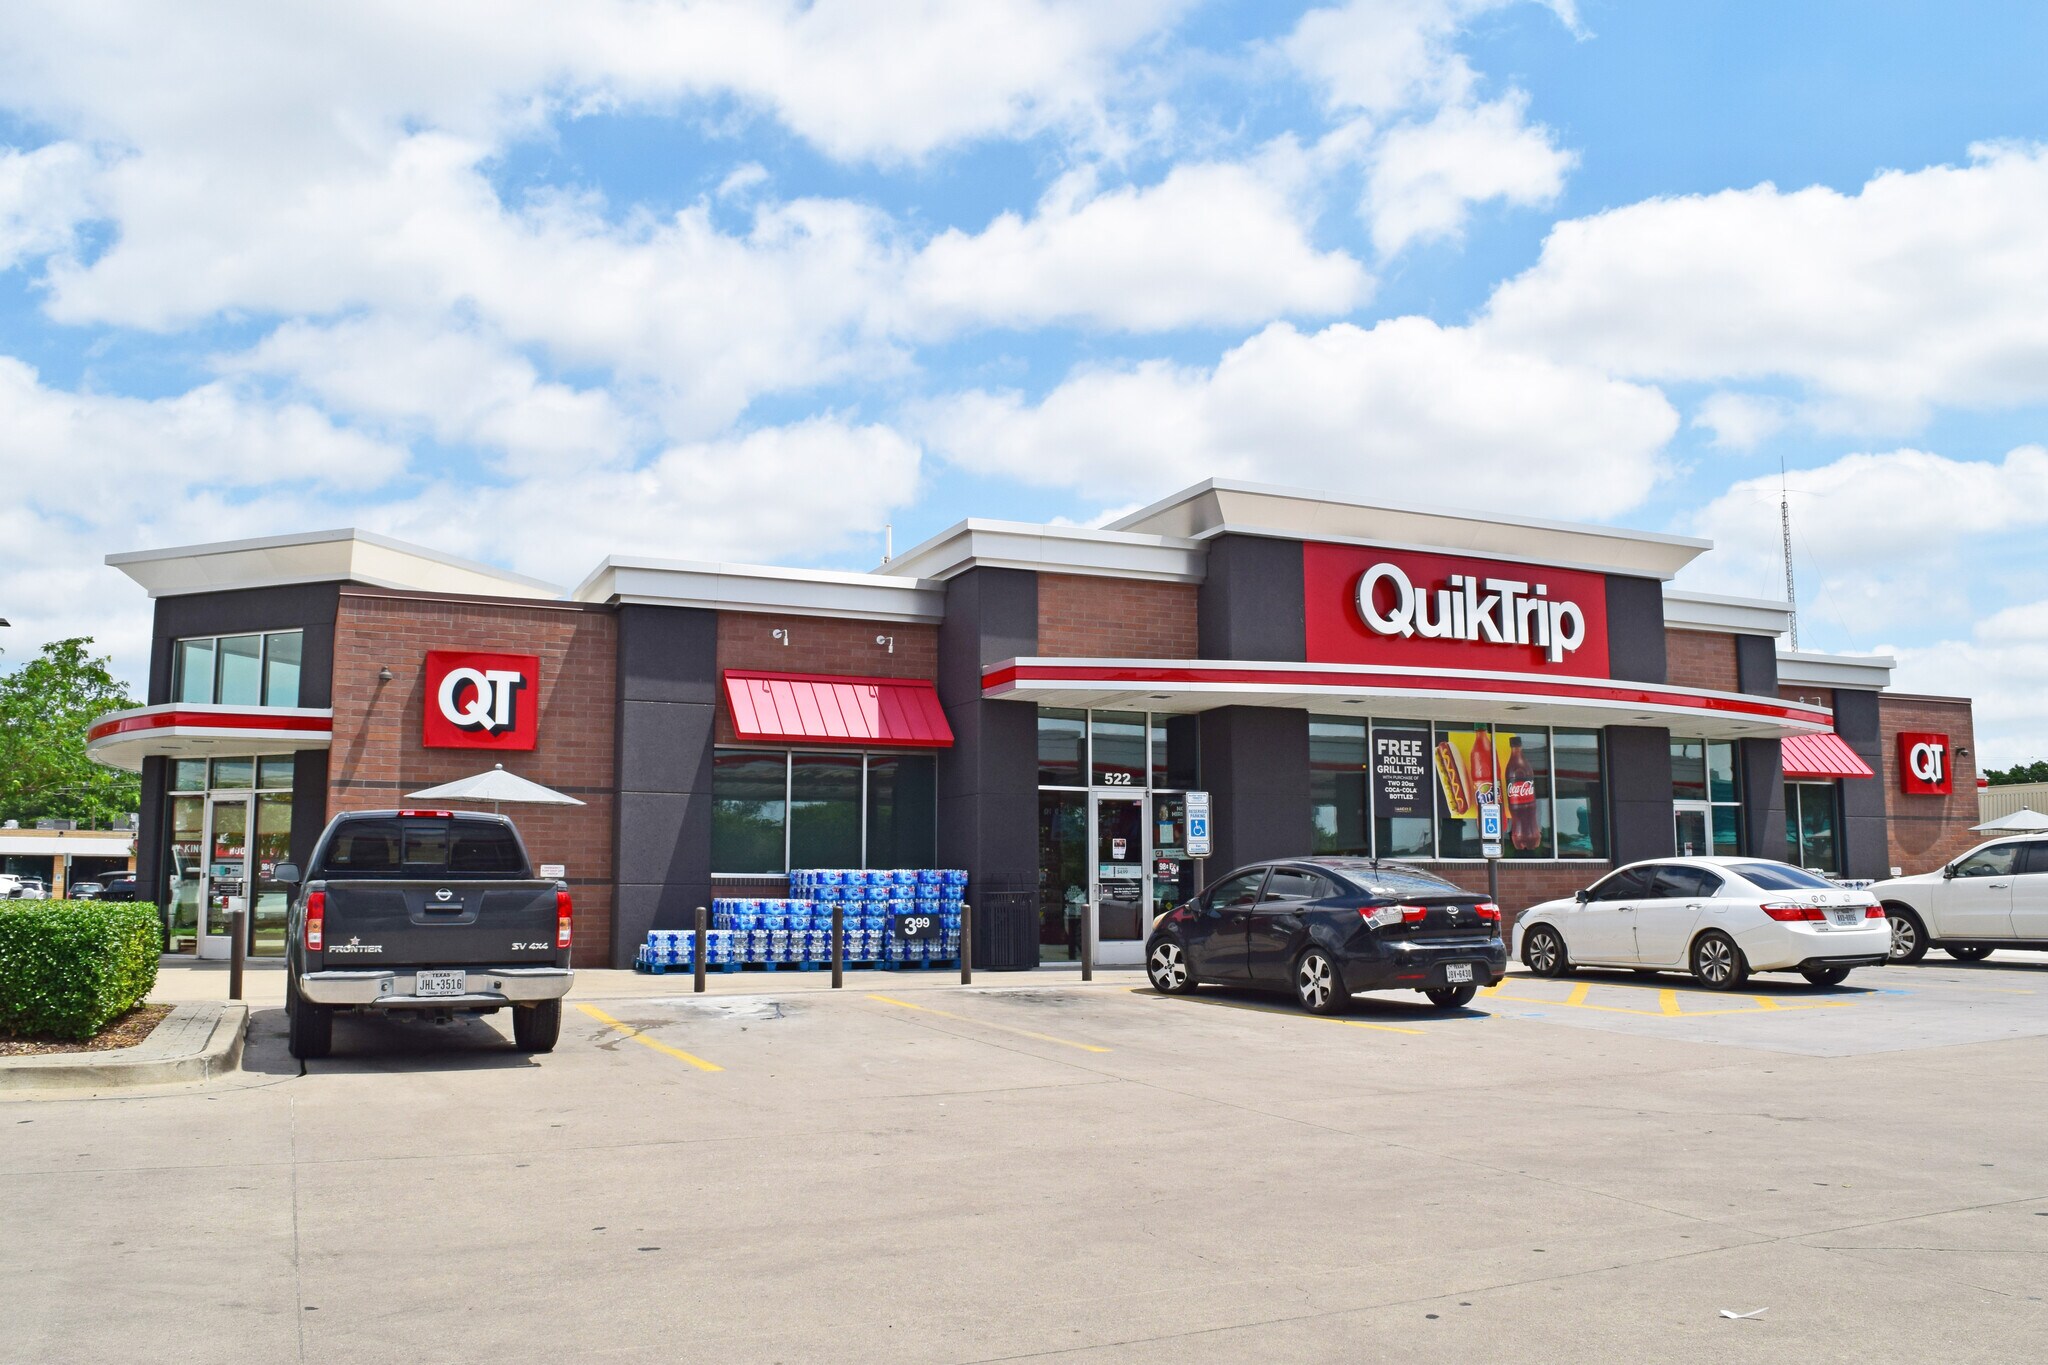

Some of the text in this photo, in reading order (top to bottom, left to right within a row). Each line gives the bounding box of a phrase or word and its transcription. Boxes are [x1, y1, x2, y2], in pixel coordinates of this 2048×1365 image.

[1356, 562, 1586, 663] QuikTrip
[438, 667, 525, 733] QT
[1377, 739, 1423, 757] FREE
[1383, 756, 1418, 766] ROLLER
[1910, 742, 1945, 783] QT
[1377, 765, 1424, 775] GRILL ITEM
[1104, 772, 1131, 785] 522
[328, 945, 383, 953] FRONTIER
[511, 942, 526, 950] SV
